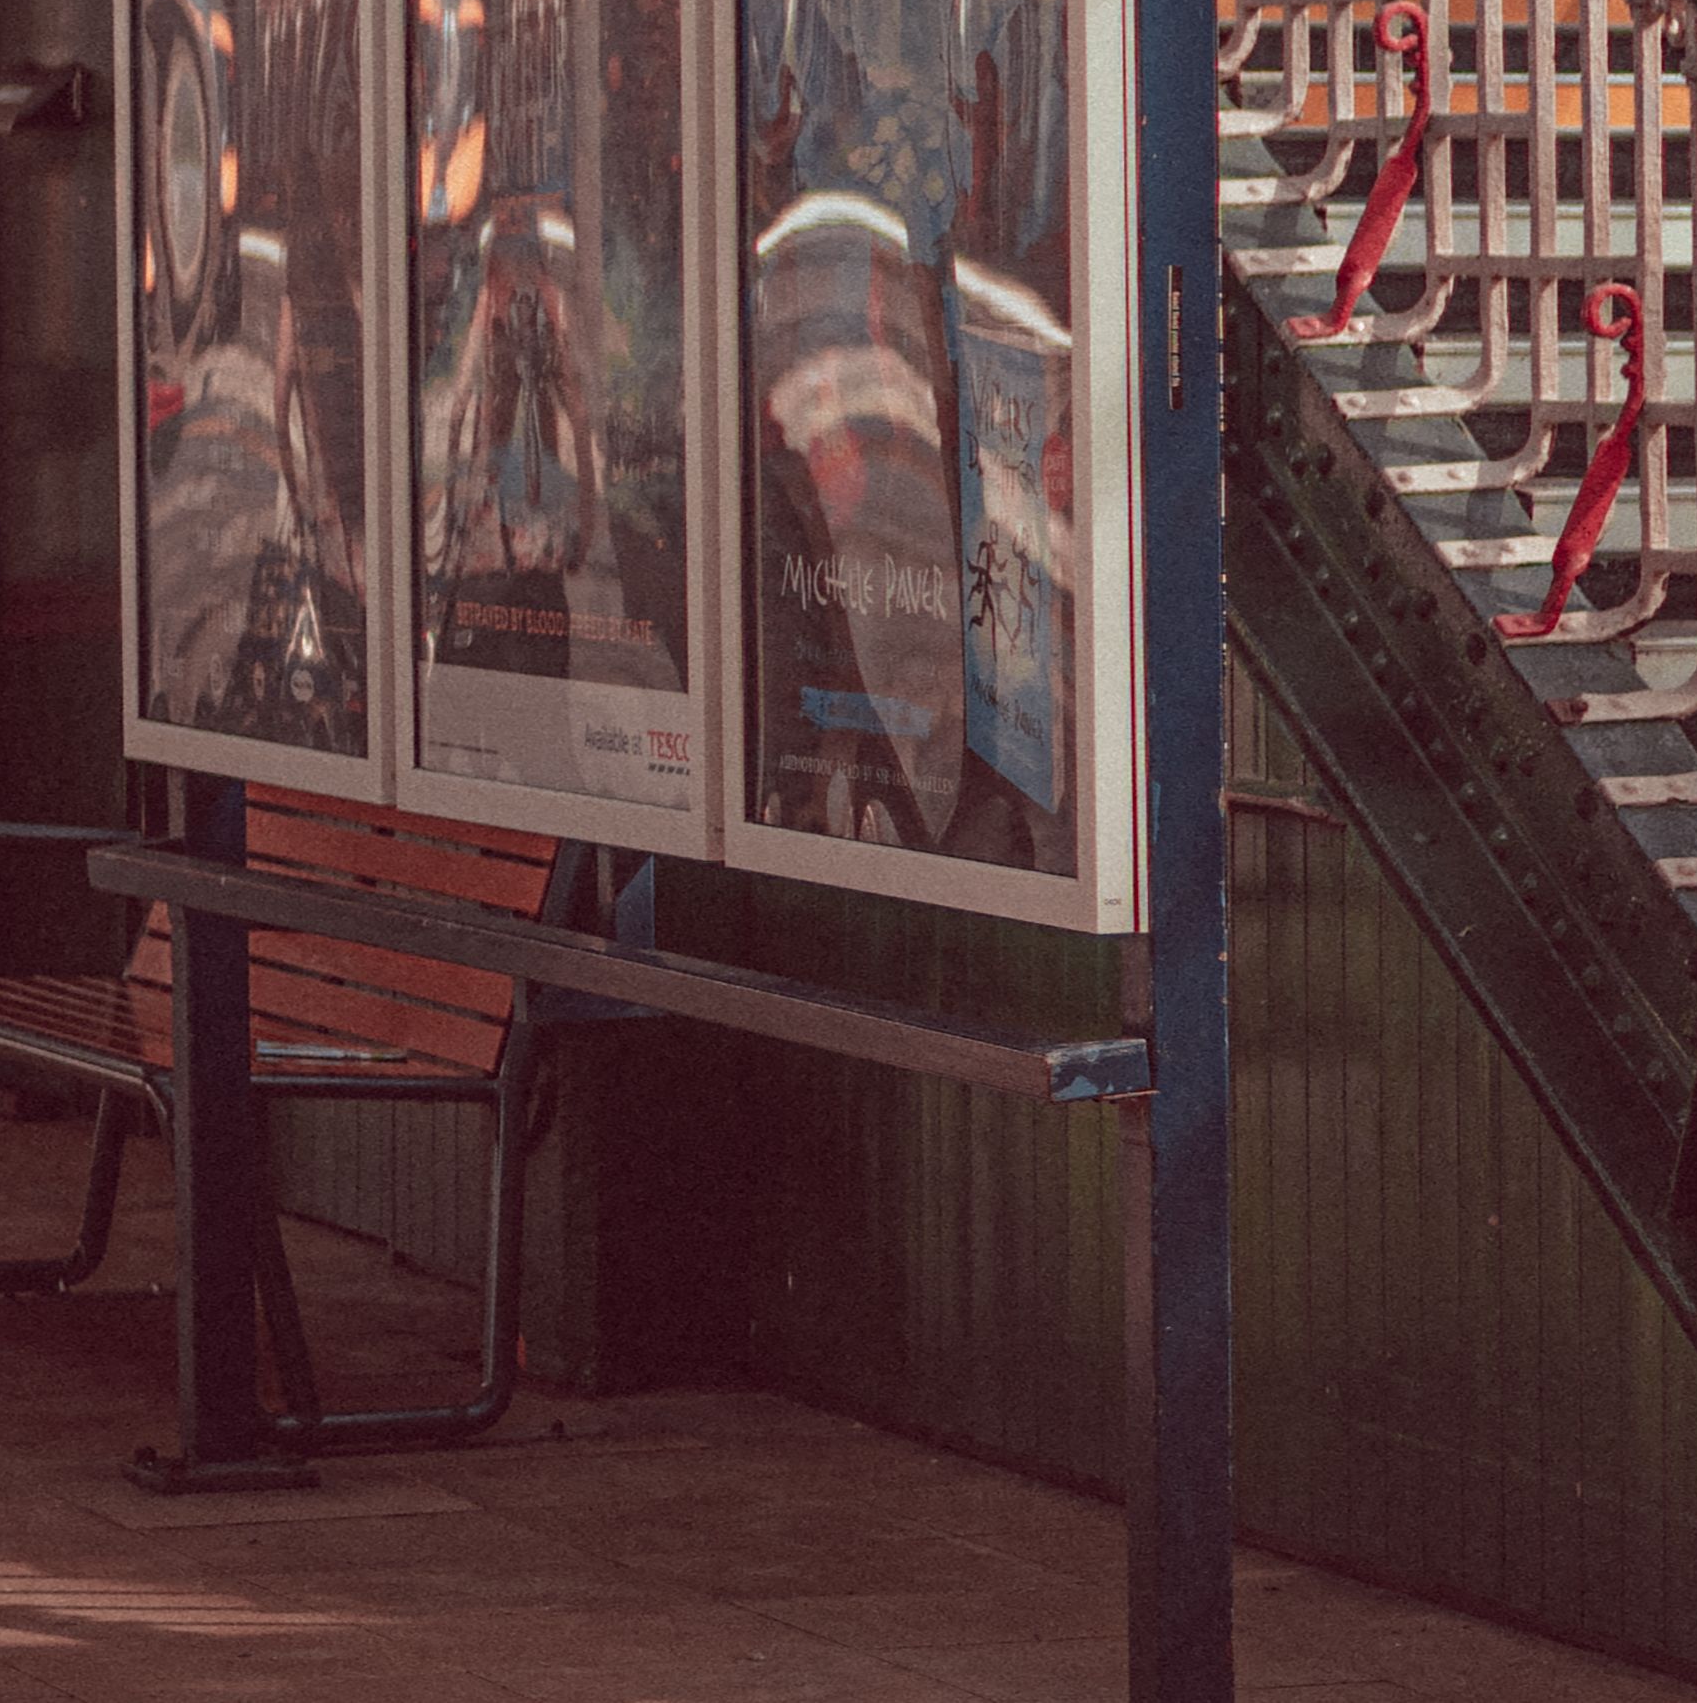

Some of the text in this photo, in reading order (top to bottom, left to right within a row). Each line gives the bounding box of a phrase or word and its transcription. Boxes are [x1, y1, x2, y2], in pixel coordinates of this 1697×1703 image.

[780, 551, 948, 622] MICHELLE PAVER
[456, 600, 510, 633] BETRAYED
[511, 605, 525, 633] BY
[584, 721, 630, 756] Available
[632, 730, 644, 756] at
